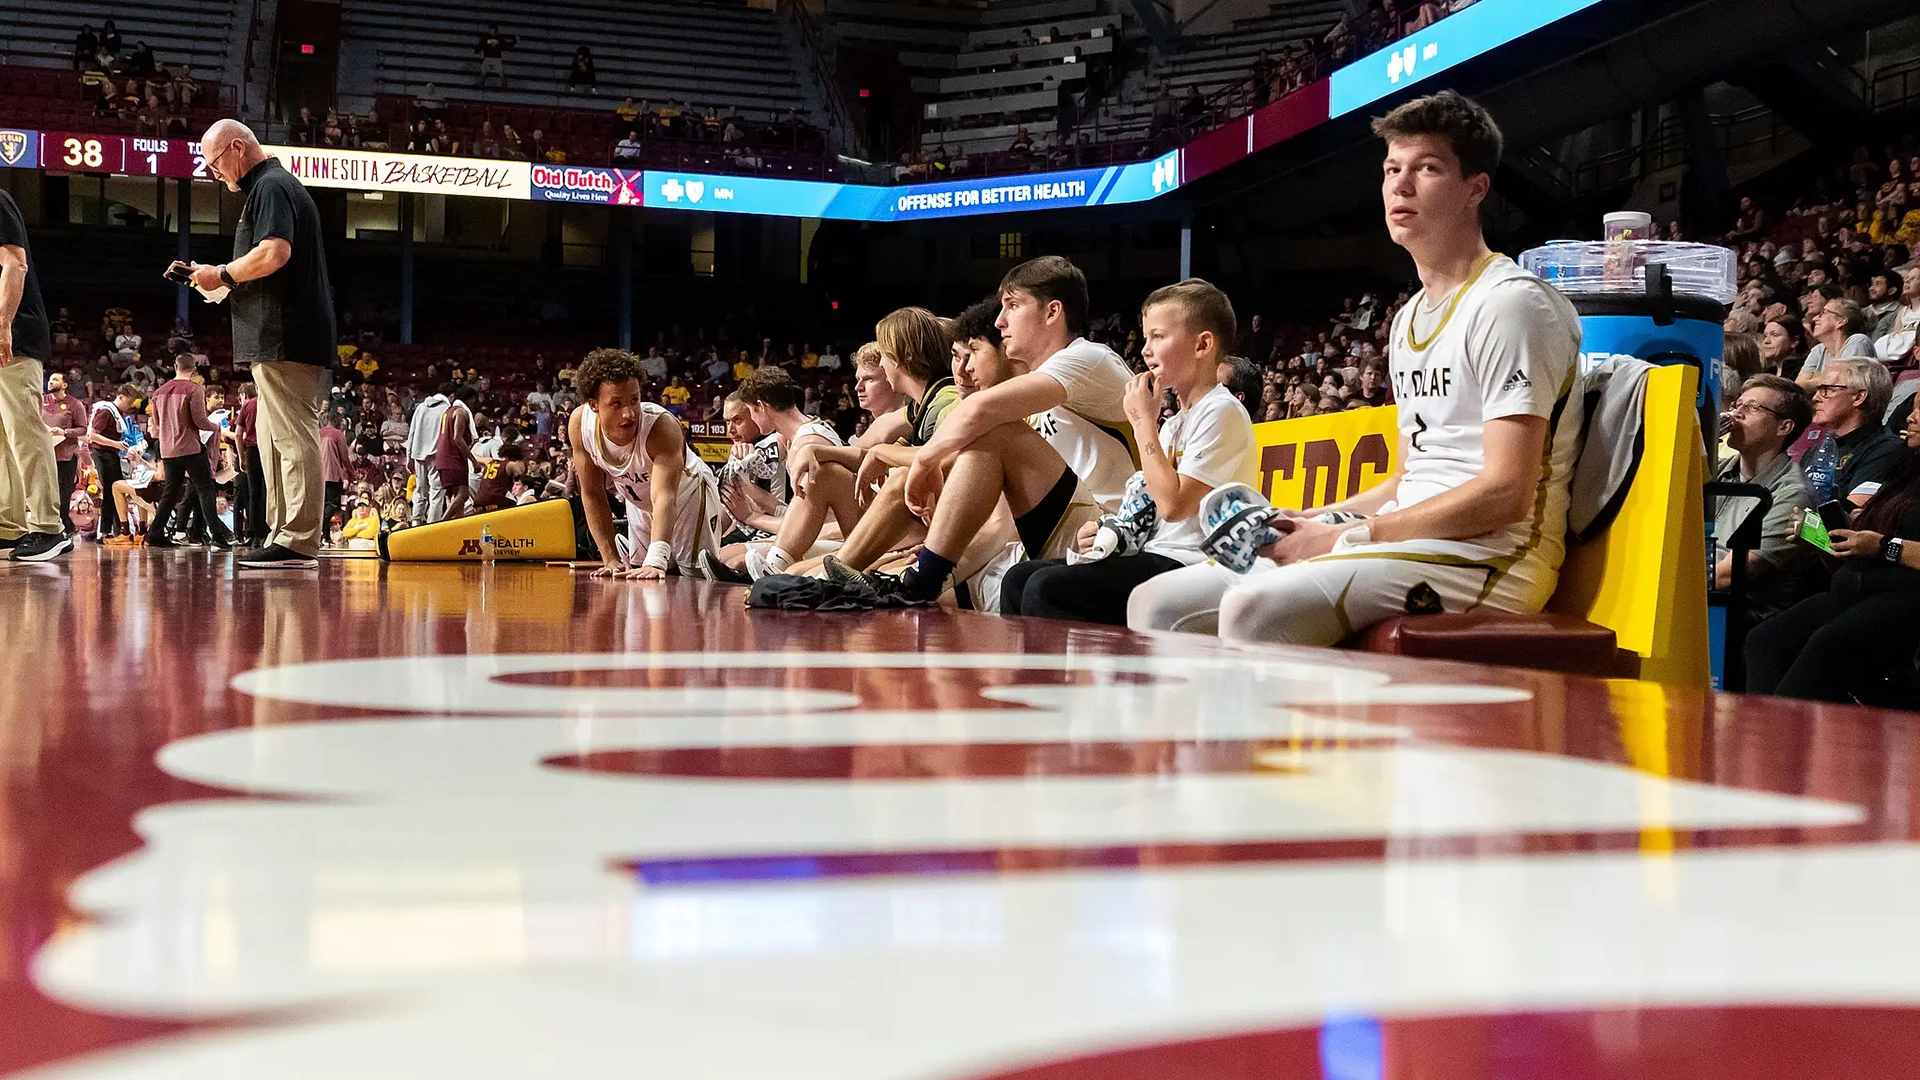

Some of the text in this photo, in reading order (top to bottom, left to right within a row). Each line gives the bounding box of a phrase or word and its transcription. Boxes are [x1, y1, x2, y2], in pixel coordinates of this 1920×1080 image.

[63, 138, 103, 167] 38
[133, 139, 168, 153] FOULS
[146, 154, 158, 174] 1
[192, 157, 207, 177] 2
[291, 156, 512, 189] MINNESOTA BASKETBALL
[533, 168, 611, 189] Old Dutch
[545, 190, 608, 201] Quality Lives Here
[714, 188, 734, 200] MN
[898, 181, 1086, 211] OFFENSE FOR BETTER HEALTH
[1411, 367, 1451, 397] OLAF
[1503, 379, 1532, 391] adidas
[691, 424, 725, 434] 102 103
[483, 462, 500, 479] 15
